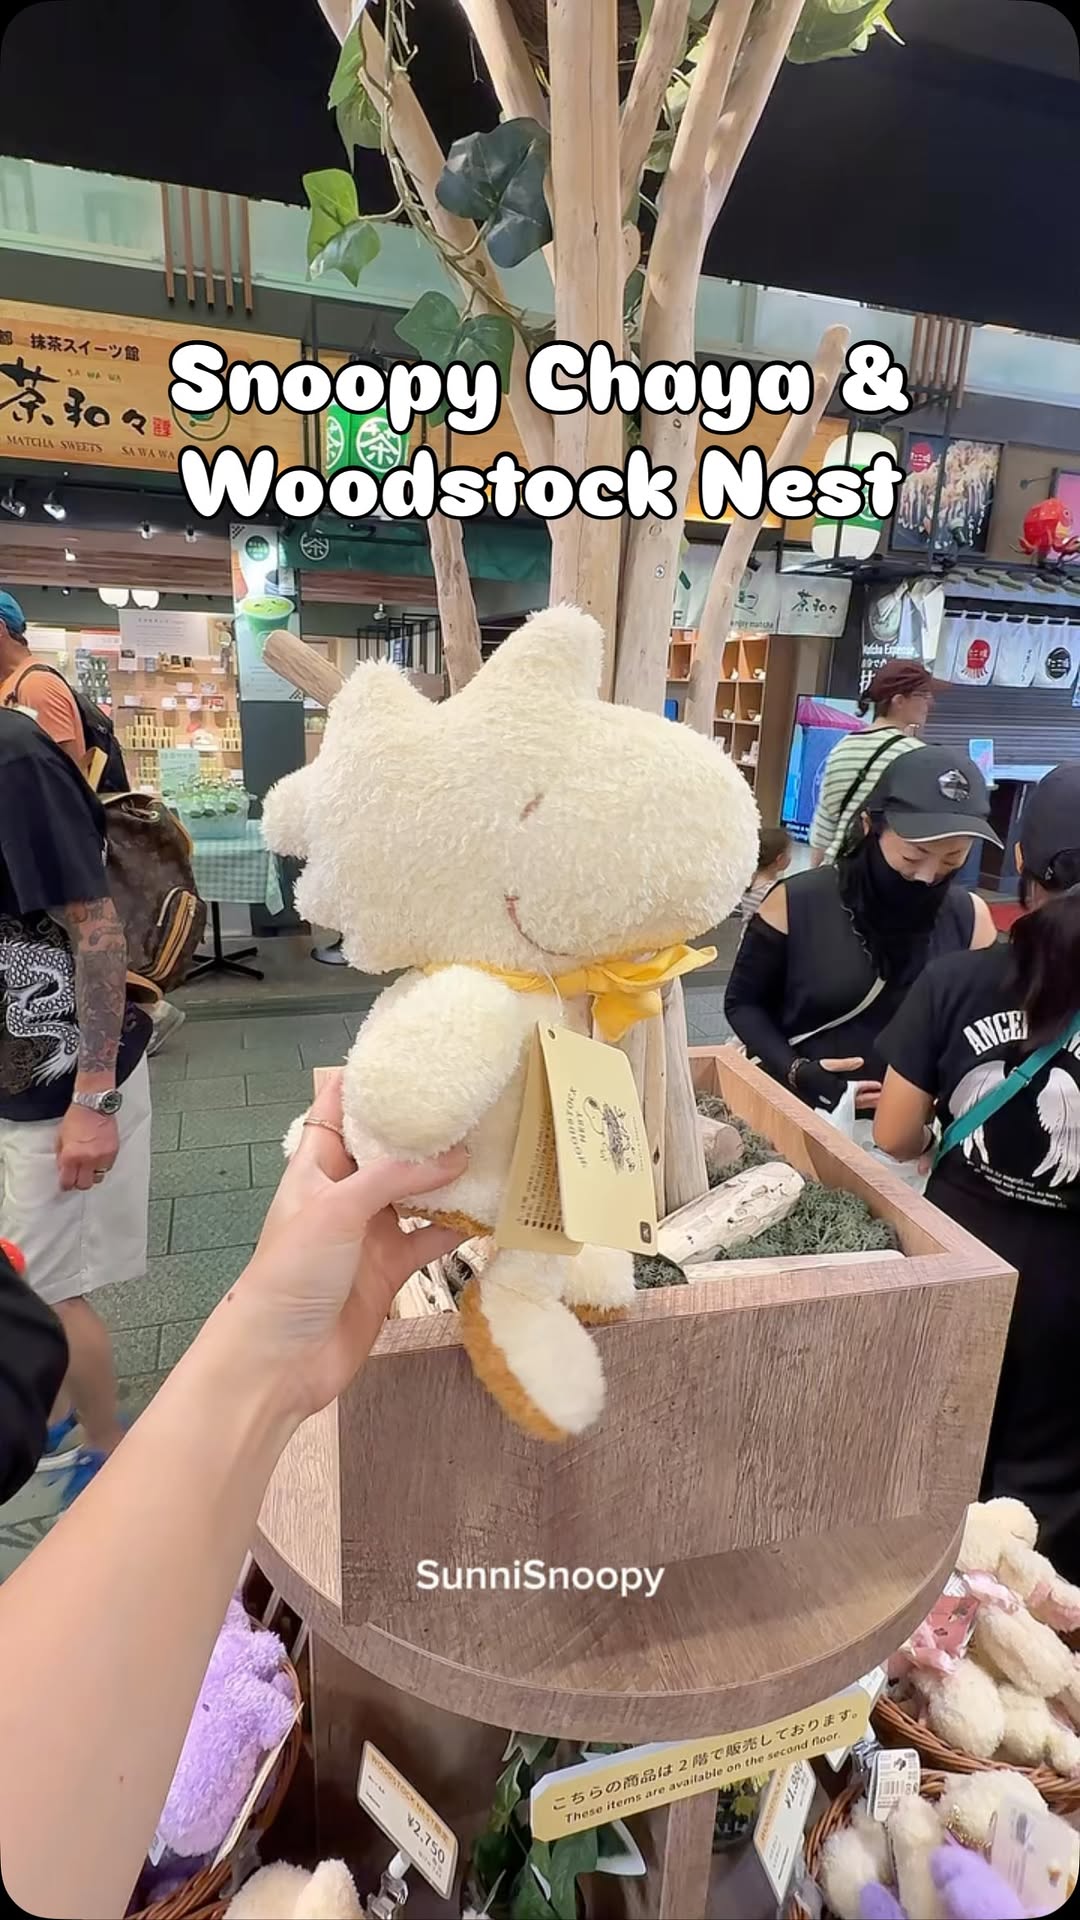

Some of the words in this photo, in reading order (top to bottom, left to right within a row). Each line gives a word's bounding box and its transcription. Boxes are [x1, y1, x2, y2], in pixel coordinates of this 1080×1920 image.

[31, 333, 140, 361] 抹茶スイーツ館
[7, 435, 54, 449] MATCHA
[61, 440, 103, 453] SWEETS
[565, 1806, 603, 1824] These
[606, 1795, 641, 1811] items
[645, 1787, 665, 1799] are
[669, 1768, 723, 1792] available
[727, 1763, 741, 1774] on
[745, 1754, 764, 1767] the
[767, 1740, 808, 1757] second
[812, 1731, 841, 1747] floor.
